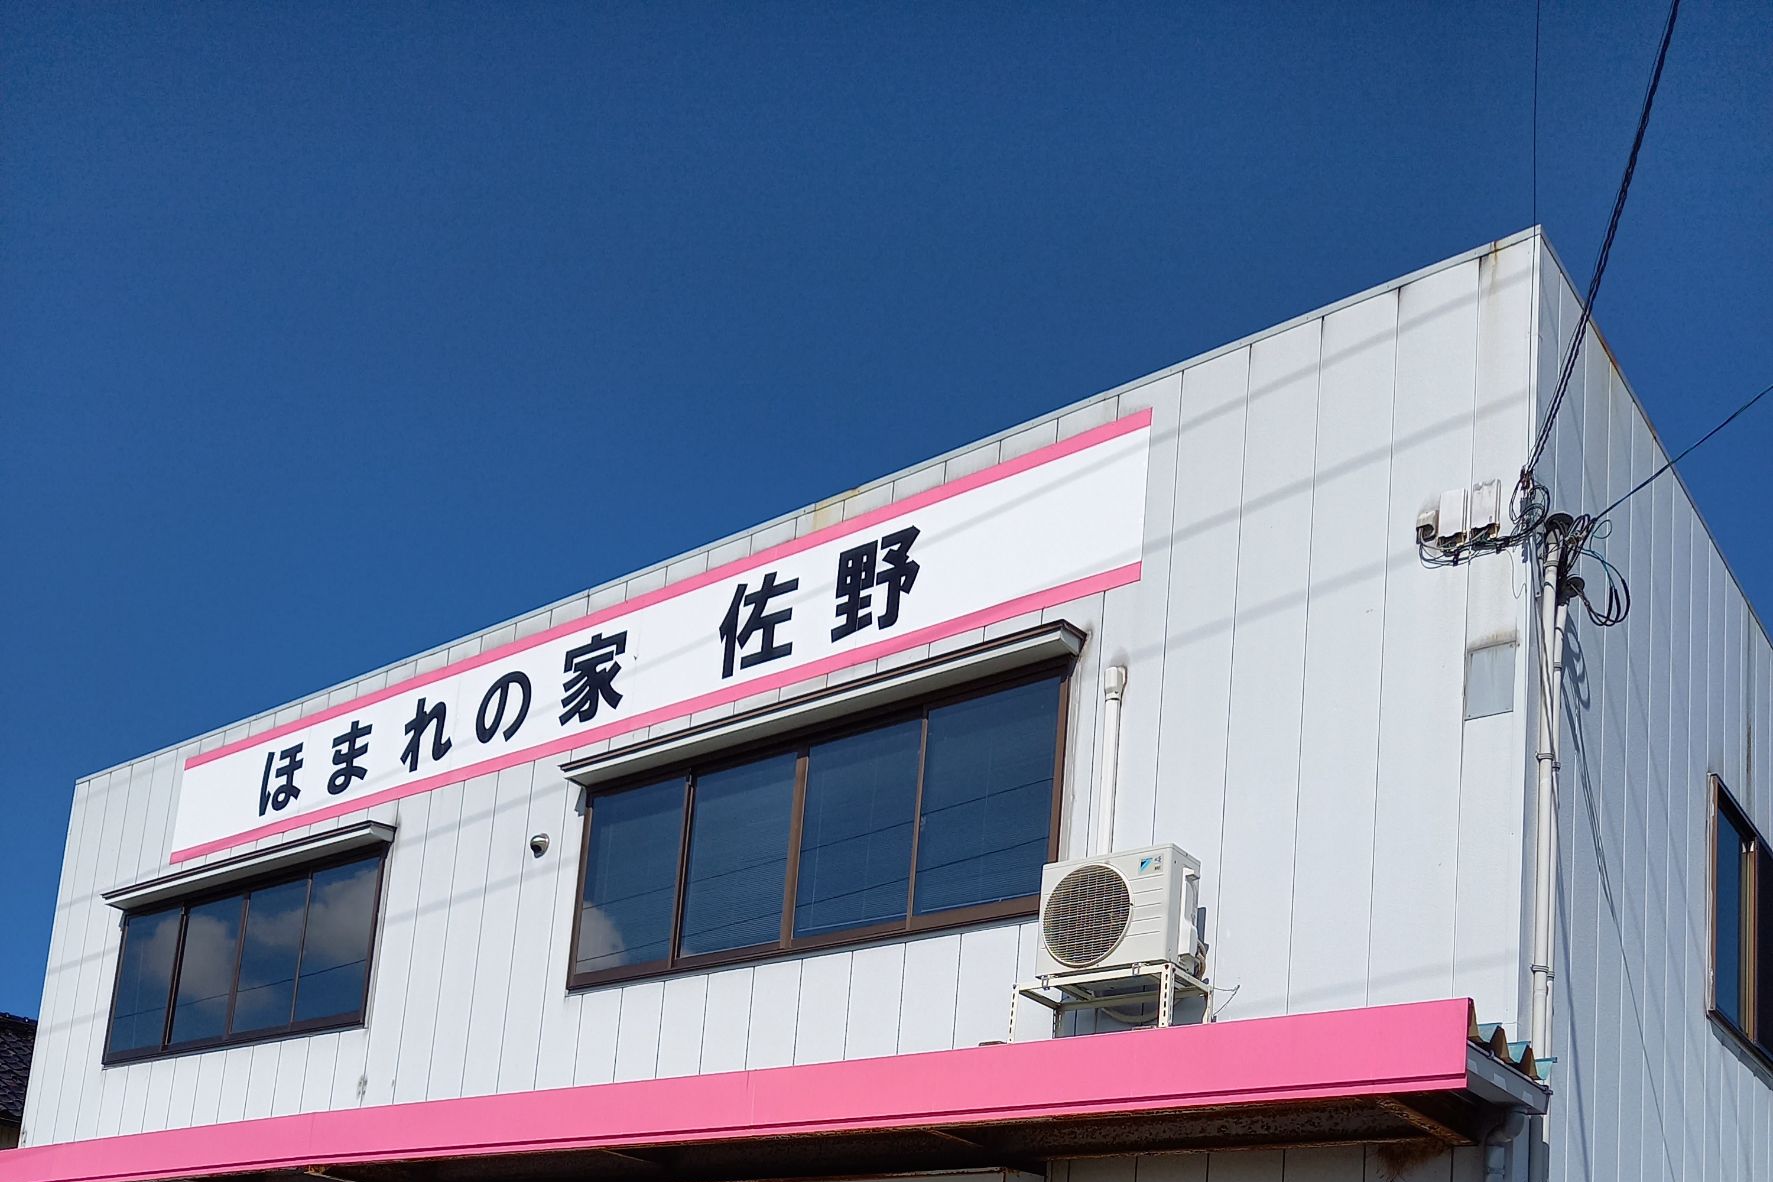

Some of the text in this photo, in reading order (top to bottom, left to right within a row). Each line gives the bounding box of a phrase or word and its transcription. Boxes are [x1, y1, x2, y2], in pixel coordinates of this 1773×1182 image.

[258, 525, 921, 817] ほまれの家 佐野
